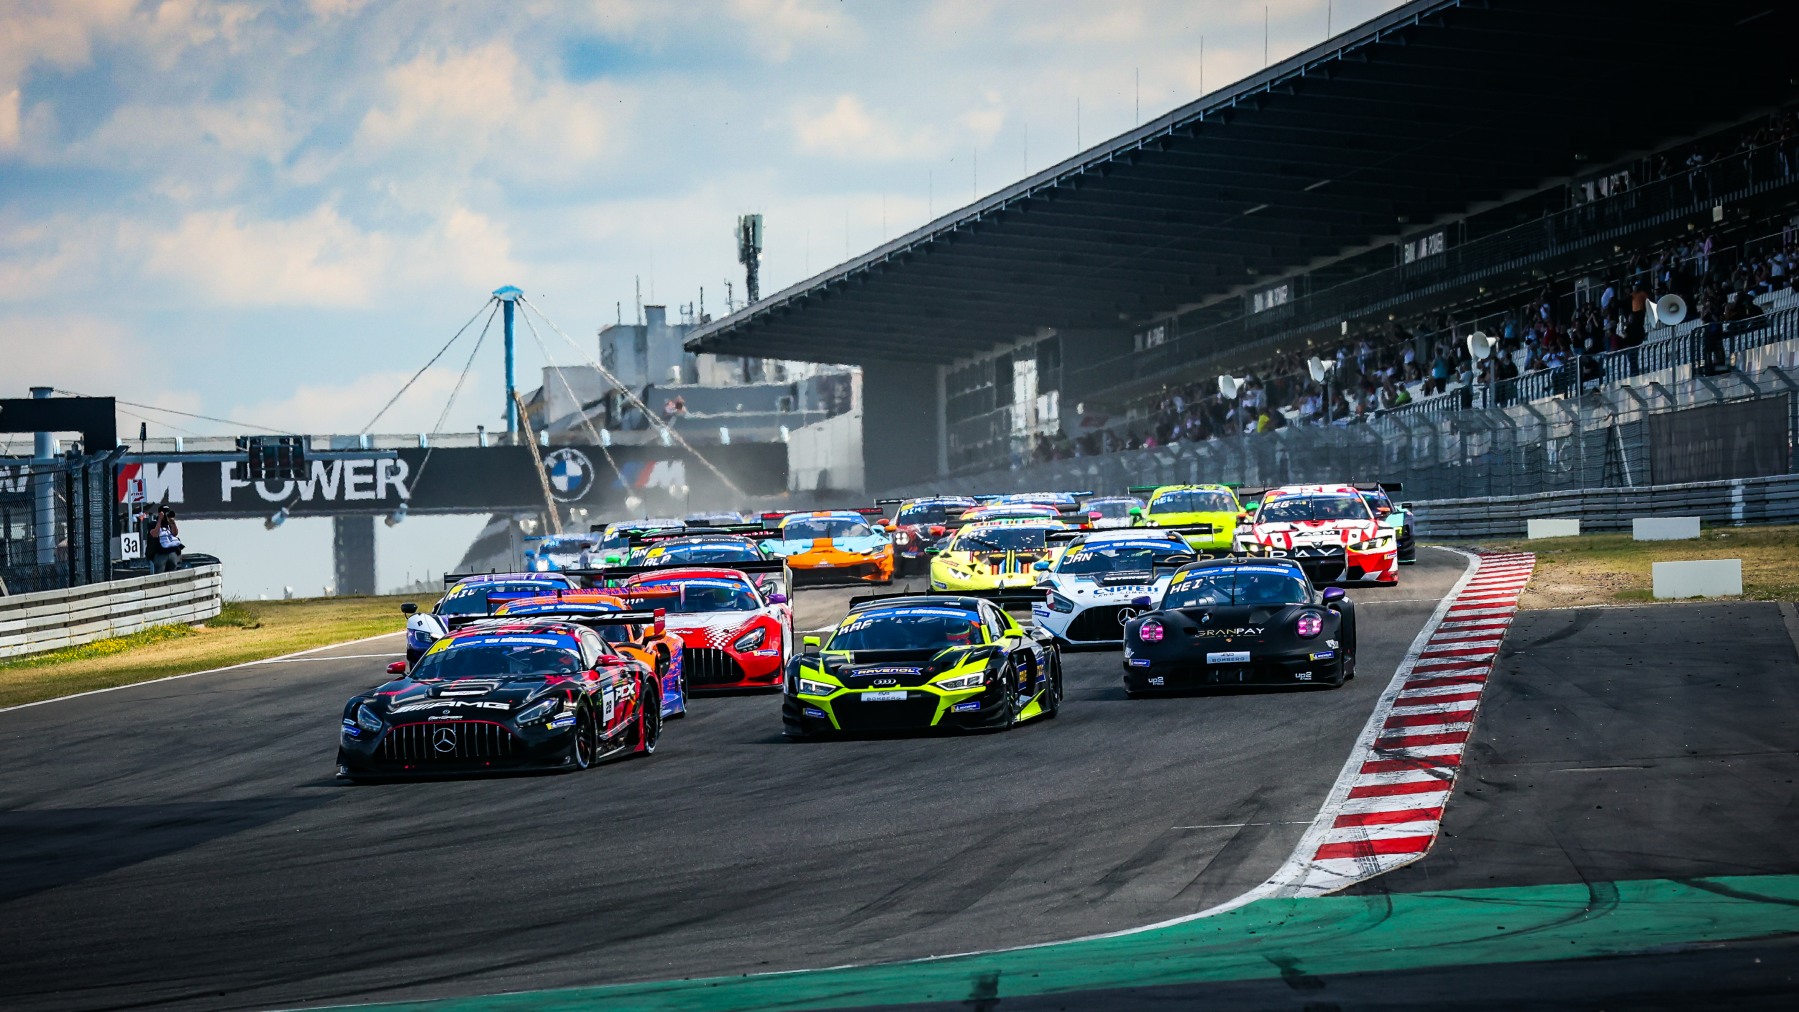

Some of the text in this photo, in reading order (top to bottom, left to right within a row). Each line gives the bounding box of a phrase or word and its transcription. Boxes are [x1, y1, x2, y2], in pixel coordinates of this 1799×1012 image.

[123, 537, 138, 554] 3a
[1063, 551, 1094, 566] JAN
[1197, 627, 1265, 637] GRANPAY
[858, 667, 917, 675] RAVENOL
[435, 701, 511, 711] AMG
